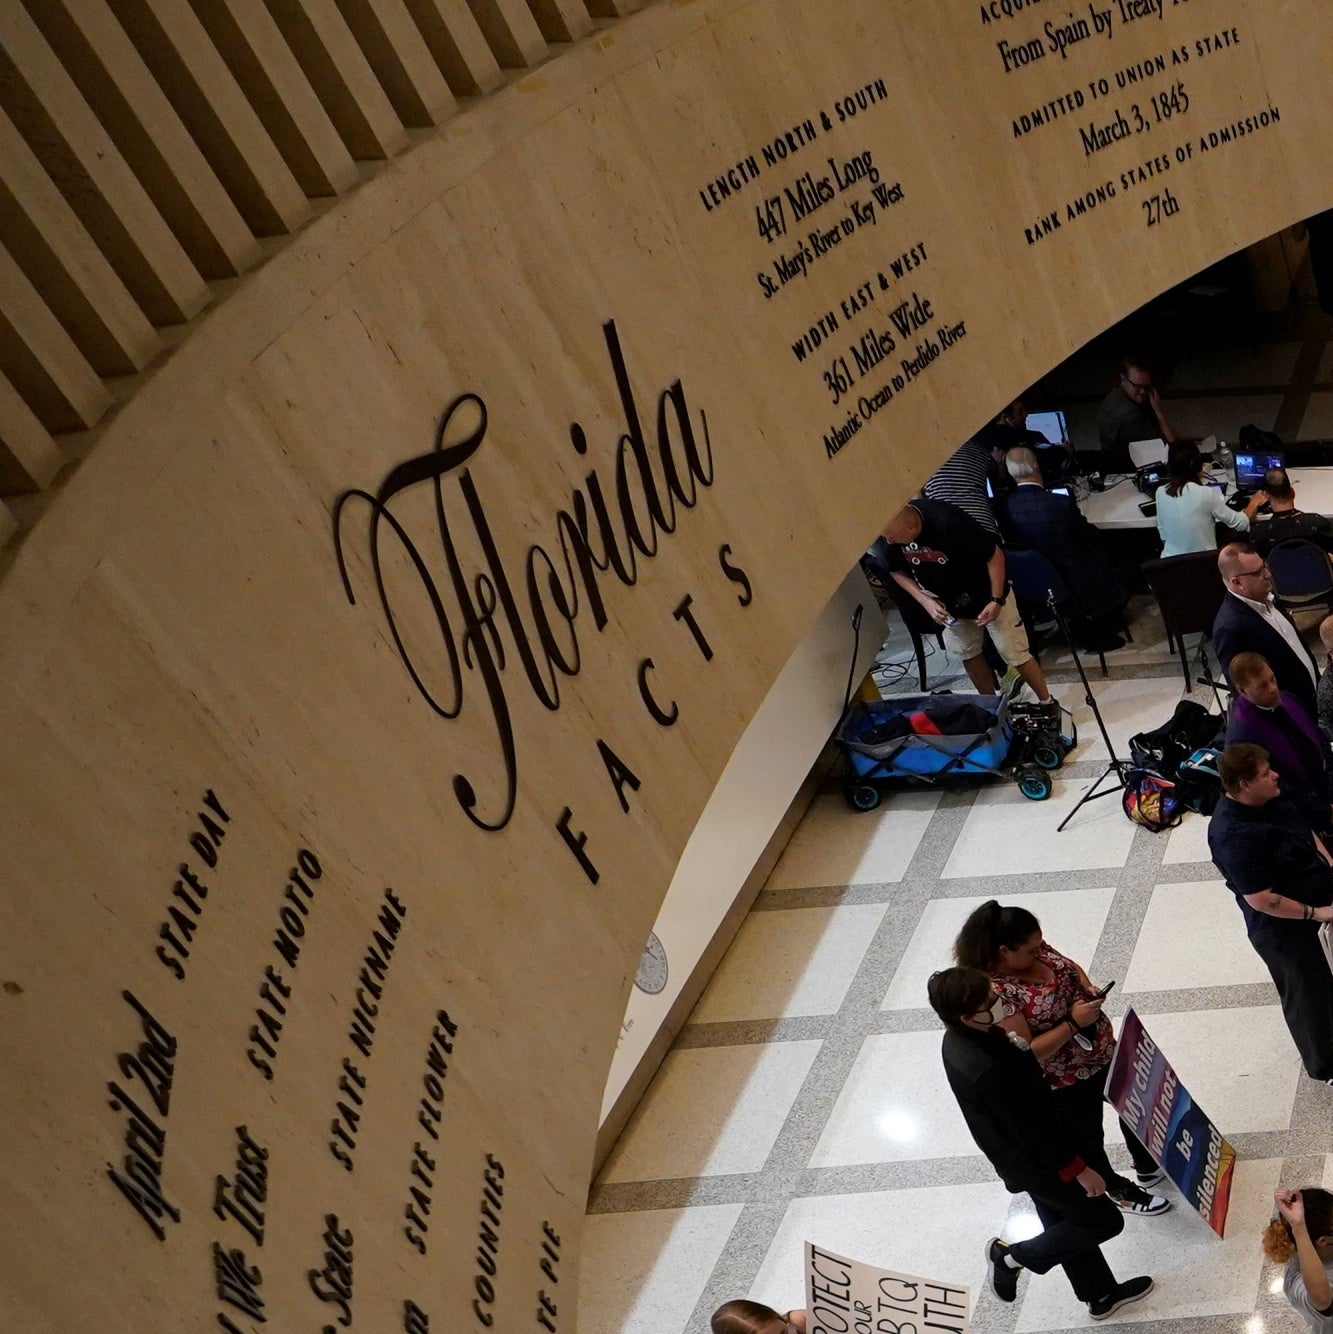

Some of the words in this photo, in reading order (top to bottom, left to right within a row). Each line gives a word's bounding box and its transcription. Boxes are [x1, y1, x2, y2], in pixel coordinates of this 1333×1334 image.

[699, 155, 761, 212] LENGTH
[761, 119, 817, 168] NORTH
[819, 111, 833, 132] &
[834, 79, 888, 122] SOUTH
[1024, 211, 1062, 245] RANK
[1066, 181, 1116, 222] AMONG
[1120, 154, 1171, 190] STATES
[1175, 142, 1193, 163] OF
[1200, 107, 1281, 153] ADMISSION
[1078, 109, 1132, 157] March
[1131, 104, 1151, 133] 3,
[1150, 81, 1190, 123] 1845
[755, 195, 787, 244] 447
[783, 171, 835, 223] Miles
[827, 150, 880, 193] Long
[1142, 187, 1181, 227] 27th
[791, 311, 840, 363] WIDTH
[840, 281, 875, 321] EAST
[877, 272, 890, 291] &
[889, 241, 928, 280] WEST
[823, 356, 855, 406] 361
[849, 327, 896, 377] Miles
[888, 292, 934, 340] Wide
[333, 319, 714, 833] Florida
[117, 989, 179, 1118] 2nd
[328, 1057, 367, 1172] STATE
[348, 887, 407, 1058] NICKNAME
[1123, 1099, 1147, 1132] My
[1136, 1028, 1158, 1093] child
[106, 1079, 181, 1243] April
[1150, 1103, 1170, 1160] will
[1161, 1069, 1178, 1110] not
[1176, 1128, 1194, 1163] be
[212, 1124, 270, 1248] Trust
[1198, 1122, 1224, 1222] silenced
[213, 1241, 268, 1323] We
[307, 1213, 354, 1327] State
[472, 1153, 505, 1328] COUNTIES
